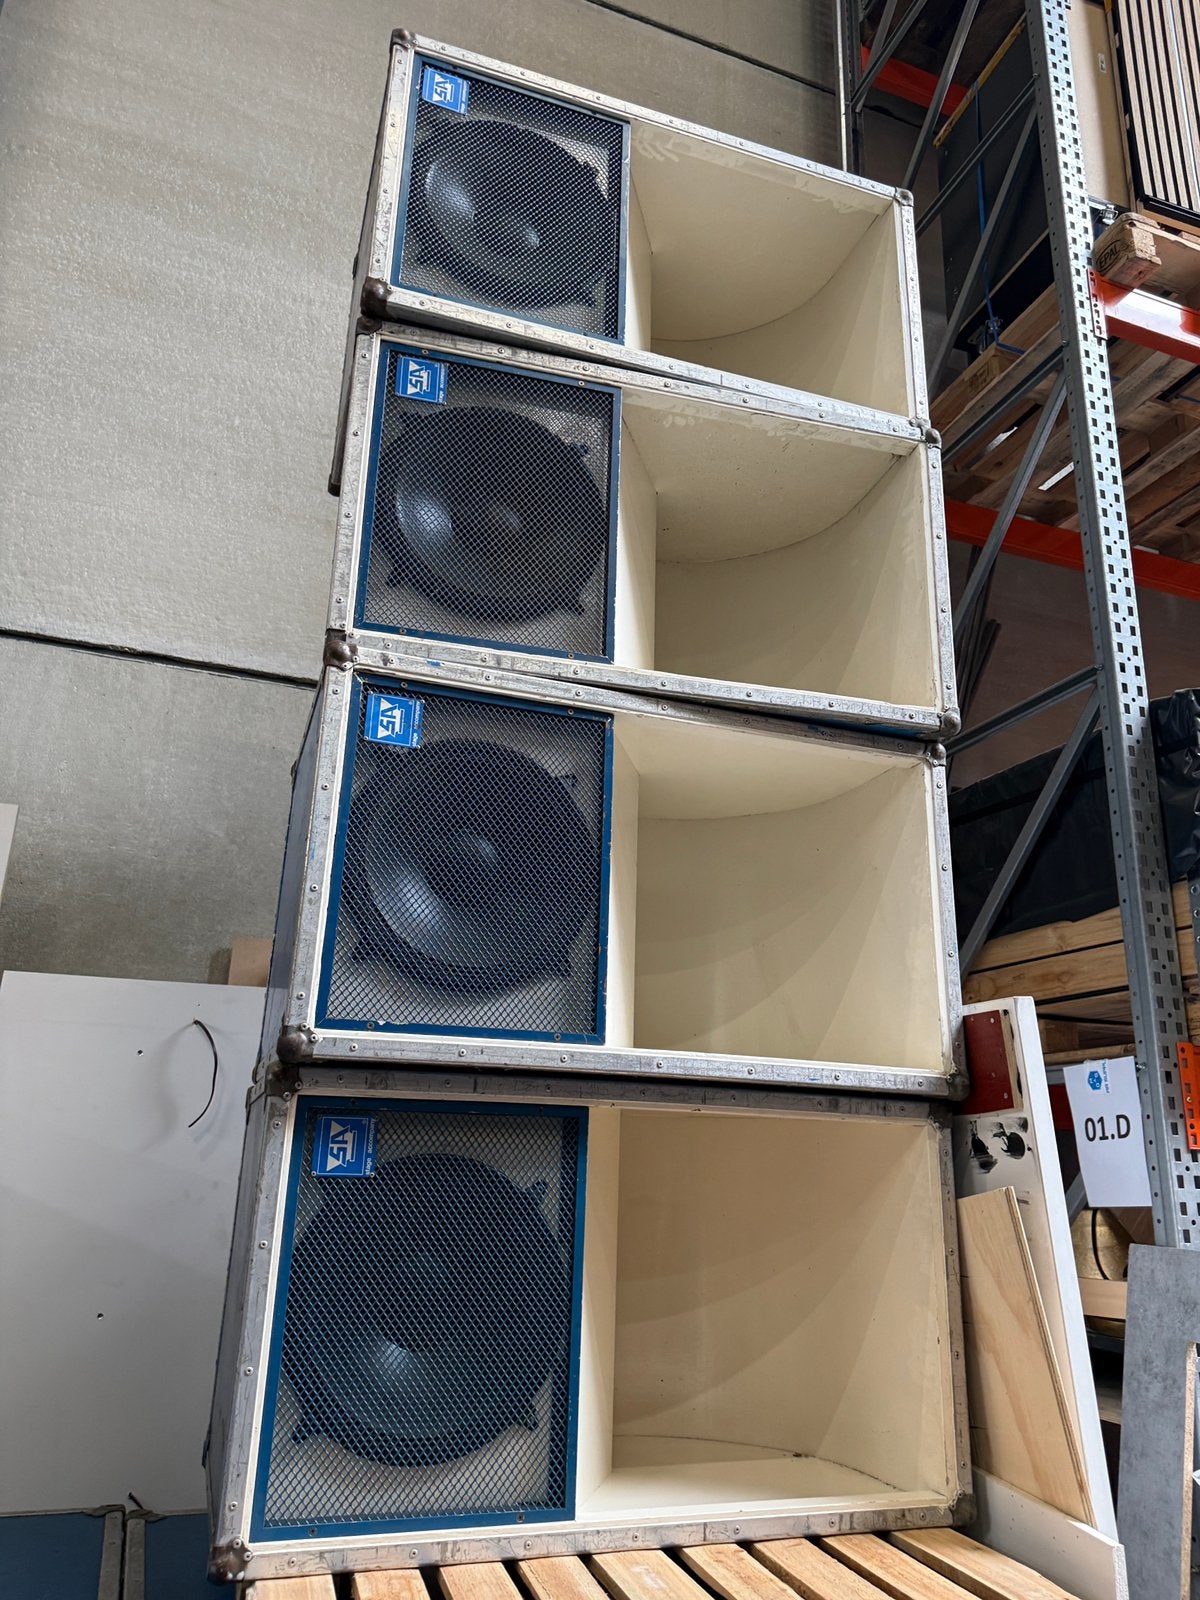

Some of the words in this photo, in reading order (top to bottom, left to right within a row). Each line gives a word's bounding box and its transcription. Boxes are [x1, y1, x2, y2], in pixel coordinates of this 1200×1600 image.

[1099, 244, 1119, 268] EPAL
[1084, 1113, 1131, 1142] 01.D
[365, 1158, 373, 1176] stage
